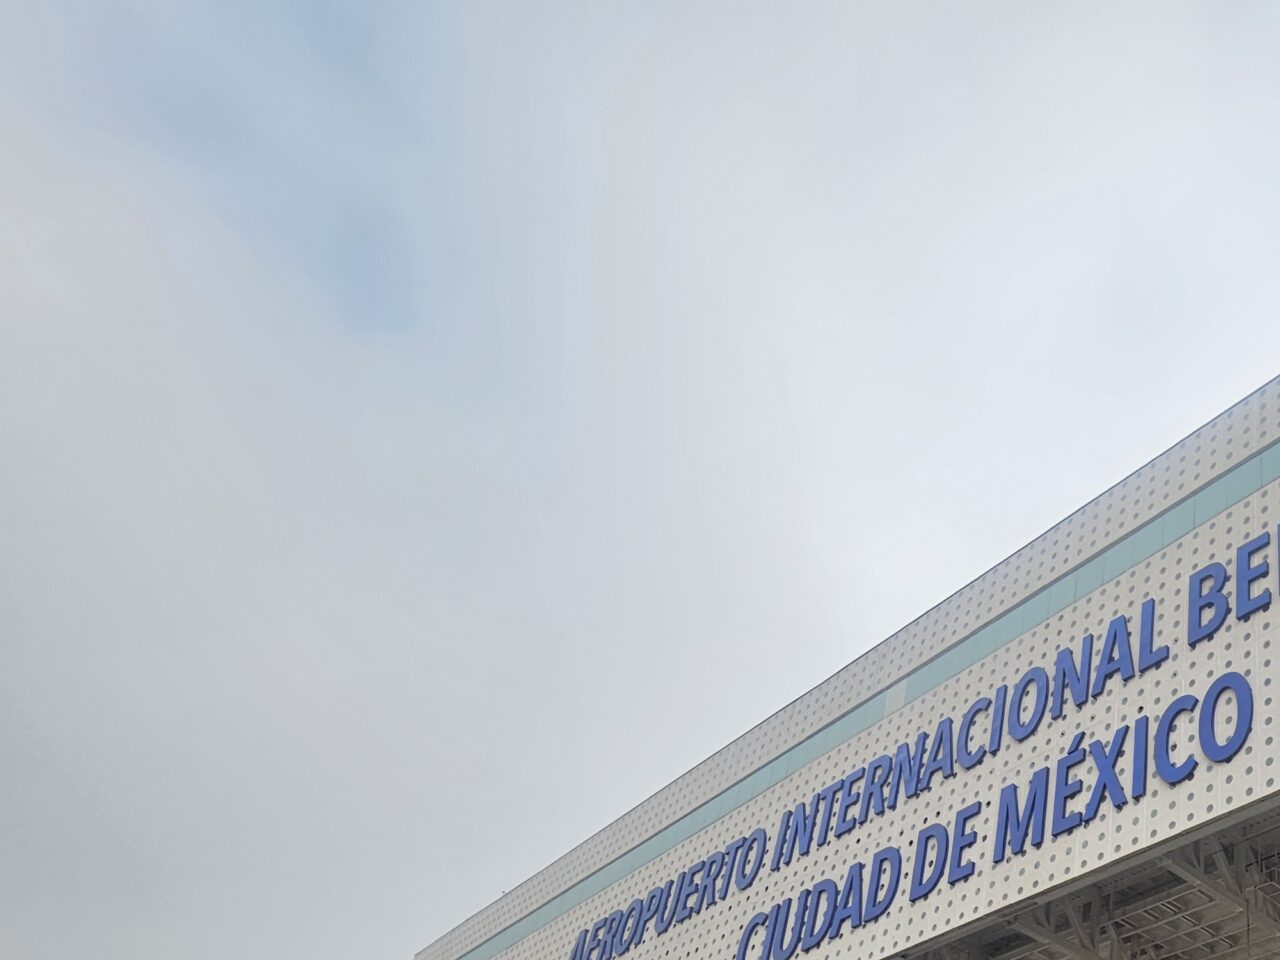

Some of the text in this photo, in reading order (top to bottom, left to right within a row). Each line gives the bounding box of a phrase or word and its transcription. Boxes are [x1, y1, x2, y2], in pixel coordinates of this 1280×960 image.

[770, 597, 1169, 871] INTERNACIONAL
[908, 800, 983, 903] DE
[992, 671, 1254, 864] MÉXICO
